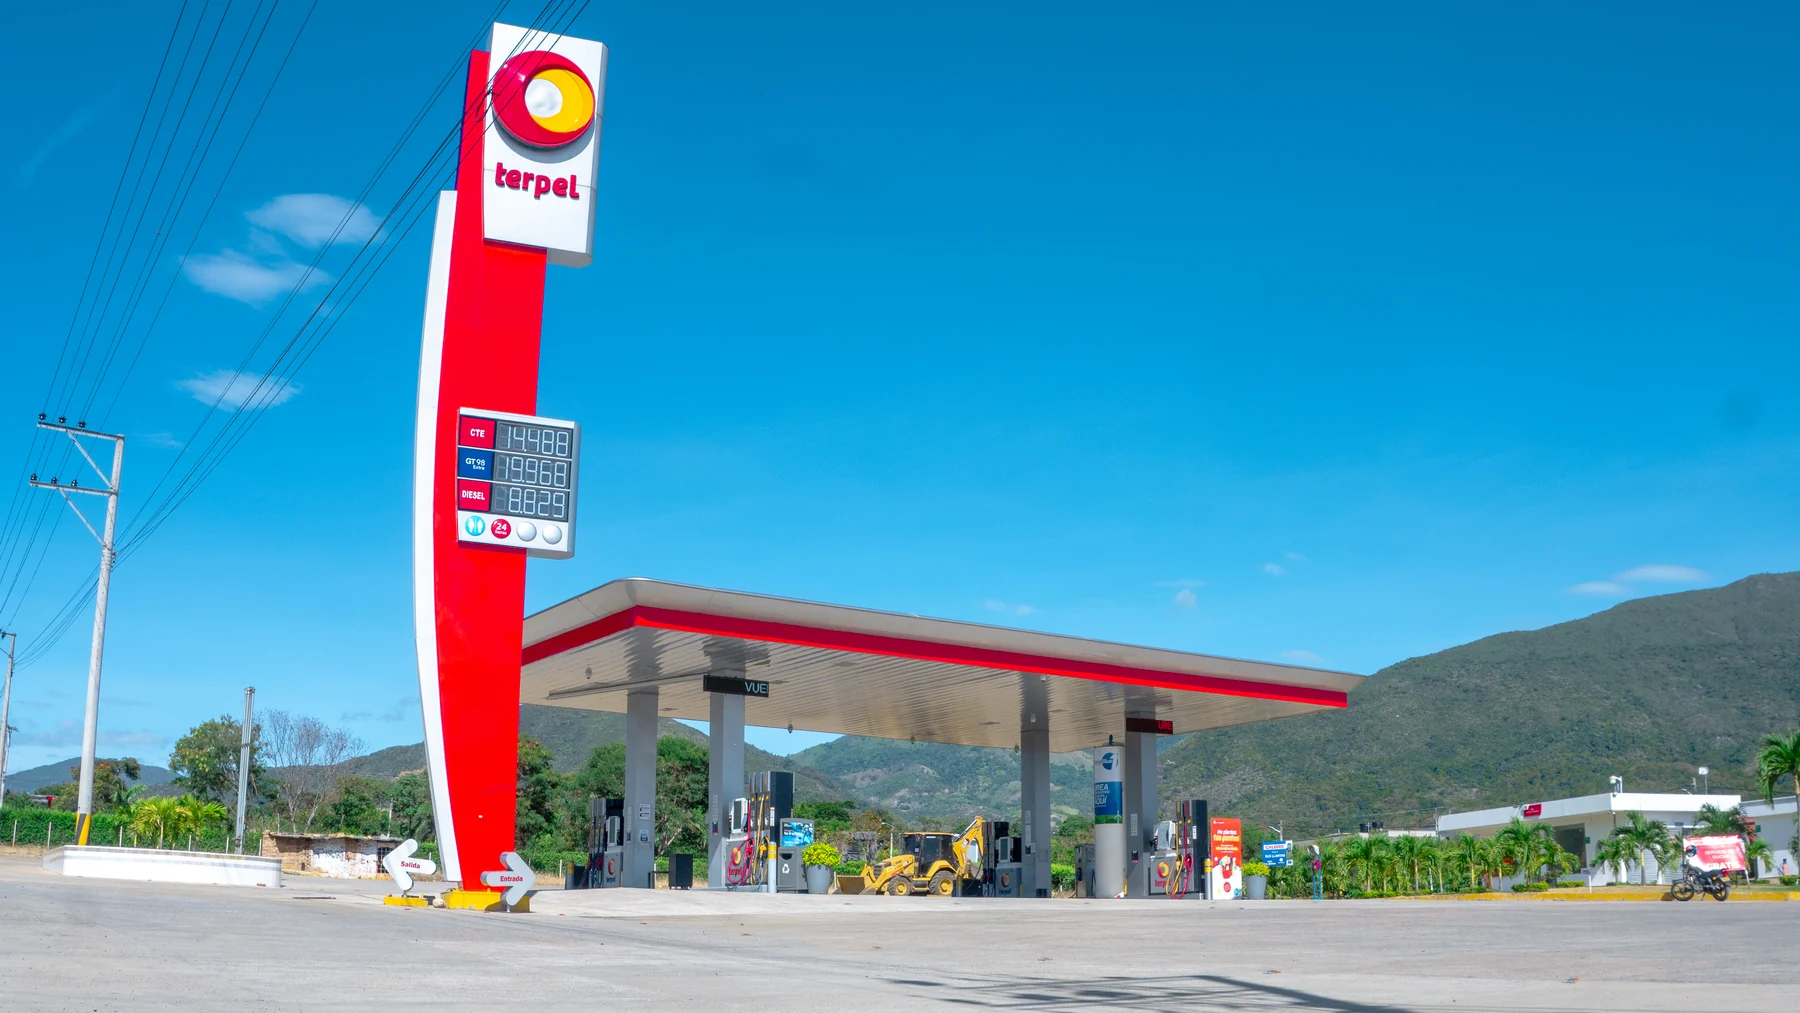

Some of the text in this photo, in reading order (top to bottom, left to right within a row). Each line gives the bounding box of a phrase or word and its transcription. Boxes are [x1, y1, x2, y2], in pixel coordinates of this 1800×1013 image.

[495, 162, 580, 199] terpel
[470, 428, 485, 438] CTE
[465, 457, 476, 465] GT
[462, 489, 485, 501] DIESEL
[496, 522, 507, 531] 24
[745, 681, 769, 694] VUE
[400, 860, 421, 869] Salida
